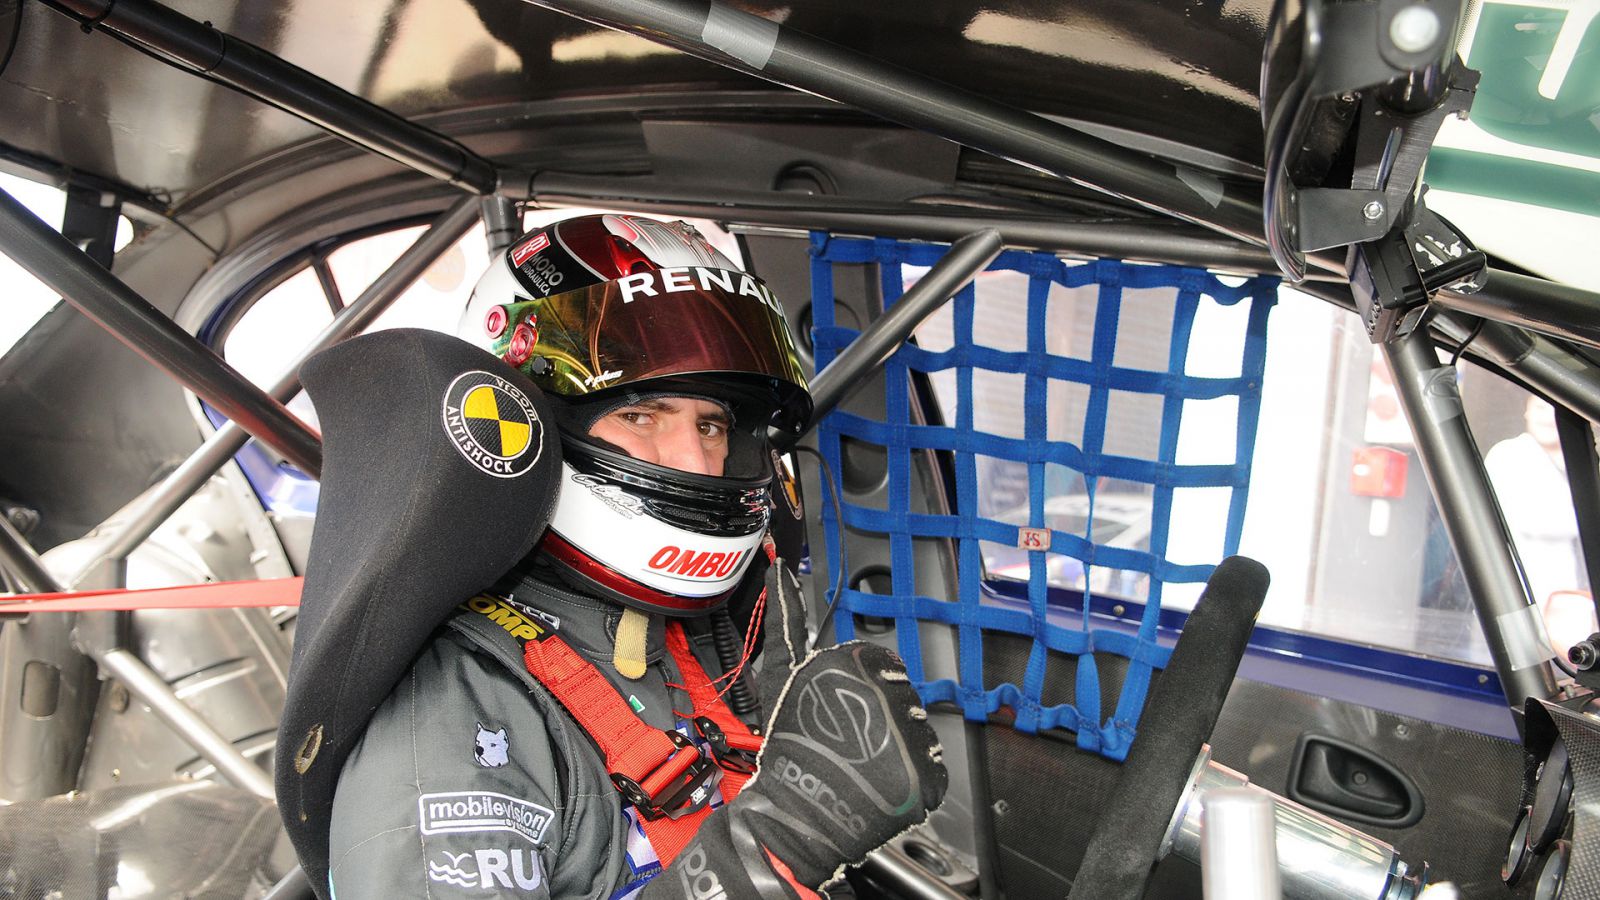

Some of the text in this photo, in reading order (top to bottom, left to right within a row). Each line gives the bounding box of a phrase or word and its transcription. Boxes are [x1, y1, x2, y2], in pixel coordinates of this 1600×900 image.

[528, 254, 564, 287] MORO
[447, 405, 514, 473] ANTISHOCK
[647, 545, 744, 578] OMBU
[468, 597, 538, 640] OMP
[429, 796, 546, 831] mobilevision
[770, 756, 867, 835] sparco
[475, 848, 550, 892] RU
